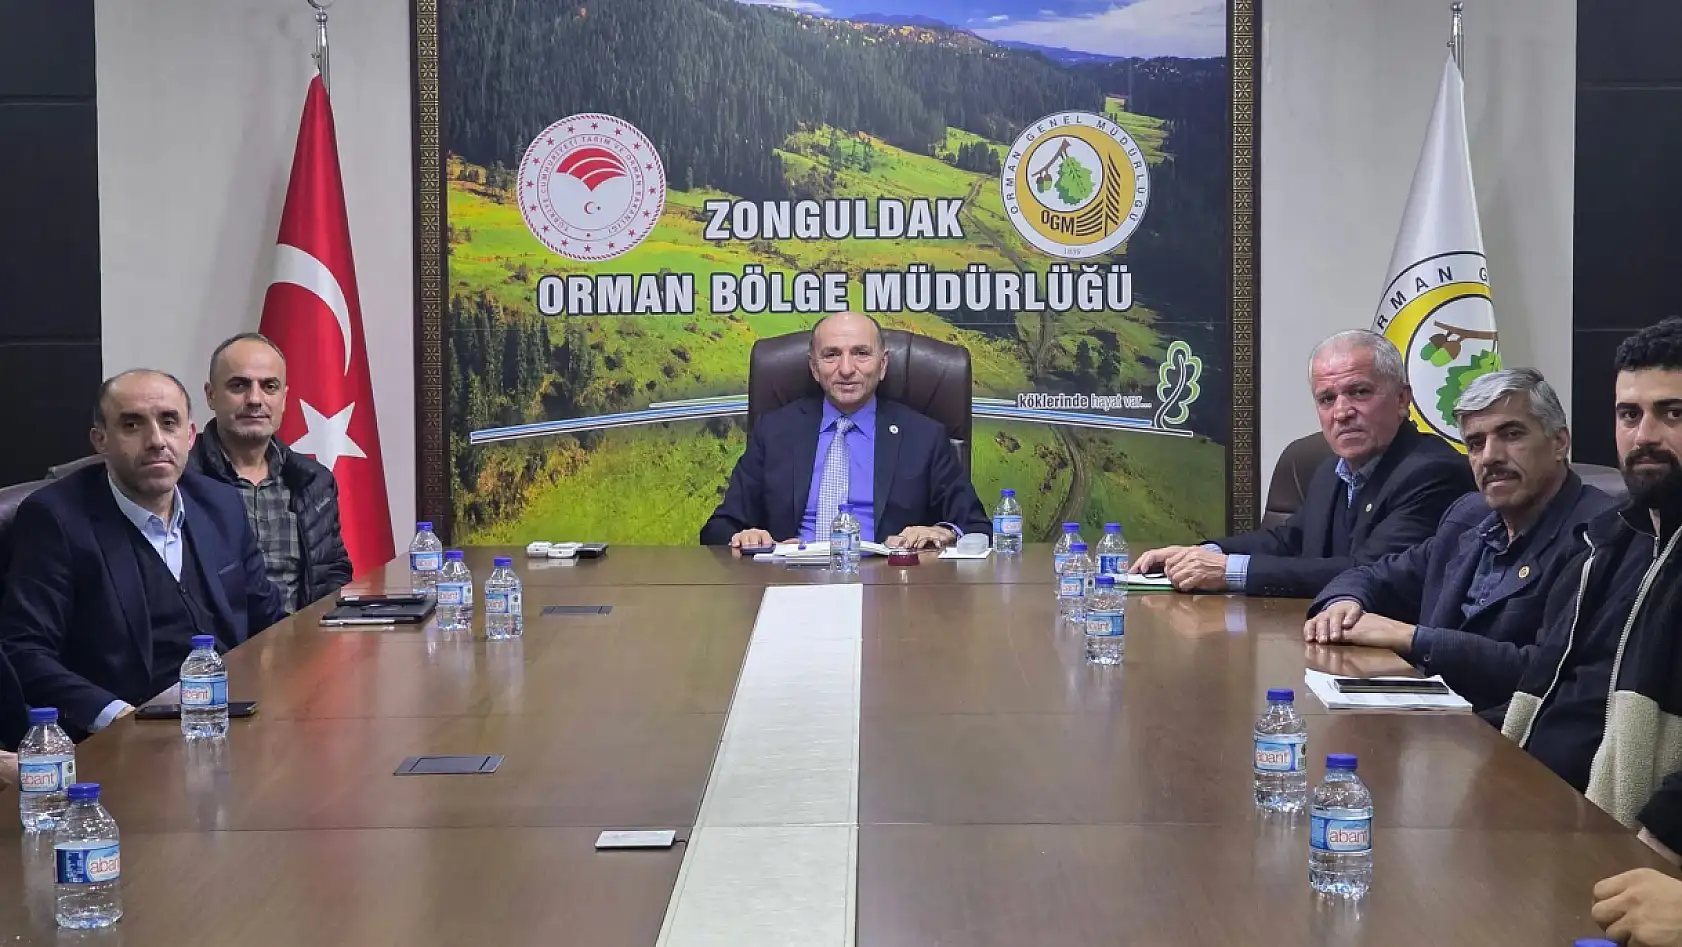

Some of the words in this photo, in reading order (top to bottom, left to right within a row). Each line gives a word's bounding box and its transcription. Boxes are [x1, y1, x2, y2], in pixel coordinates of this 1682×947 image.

[1005, 151, 1022, 214] ORMAN
[1026, 115, 1082, 142] GENEL
[705, 199, 965, 239] ZONGULDAK
[1041, 210, 1075, 236] OGM
[537, 273, 694, 315] ORMAN
[710, 265, 849, 314] BÖLGE
[863, 264, 1133, 313] MÜDÜRLÜĞÜ
[1377, 266, 1454, 330] RMAN
[1018, 393, 1088, 408] köklerinde
[1091, 393, 1122, 411] hayat
[21, 772, 55, 786] abant
[1330, 828, 1368, 844] abant
